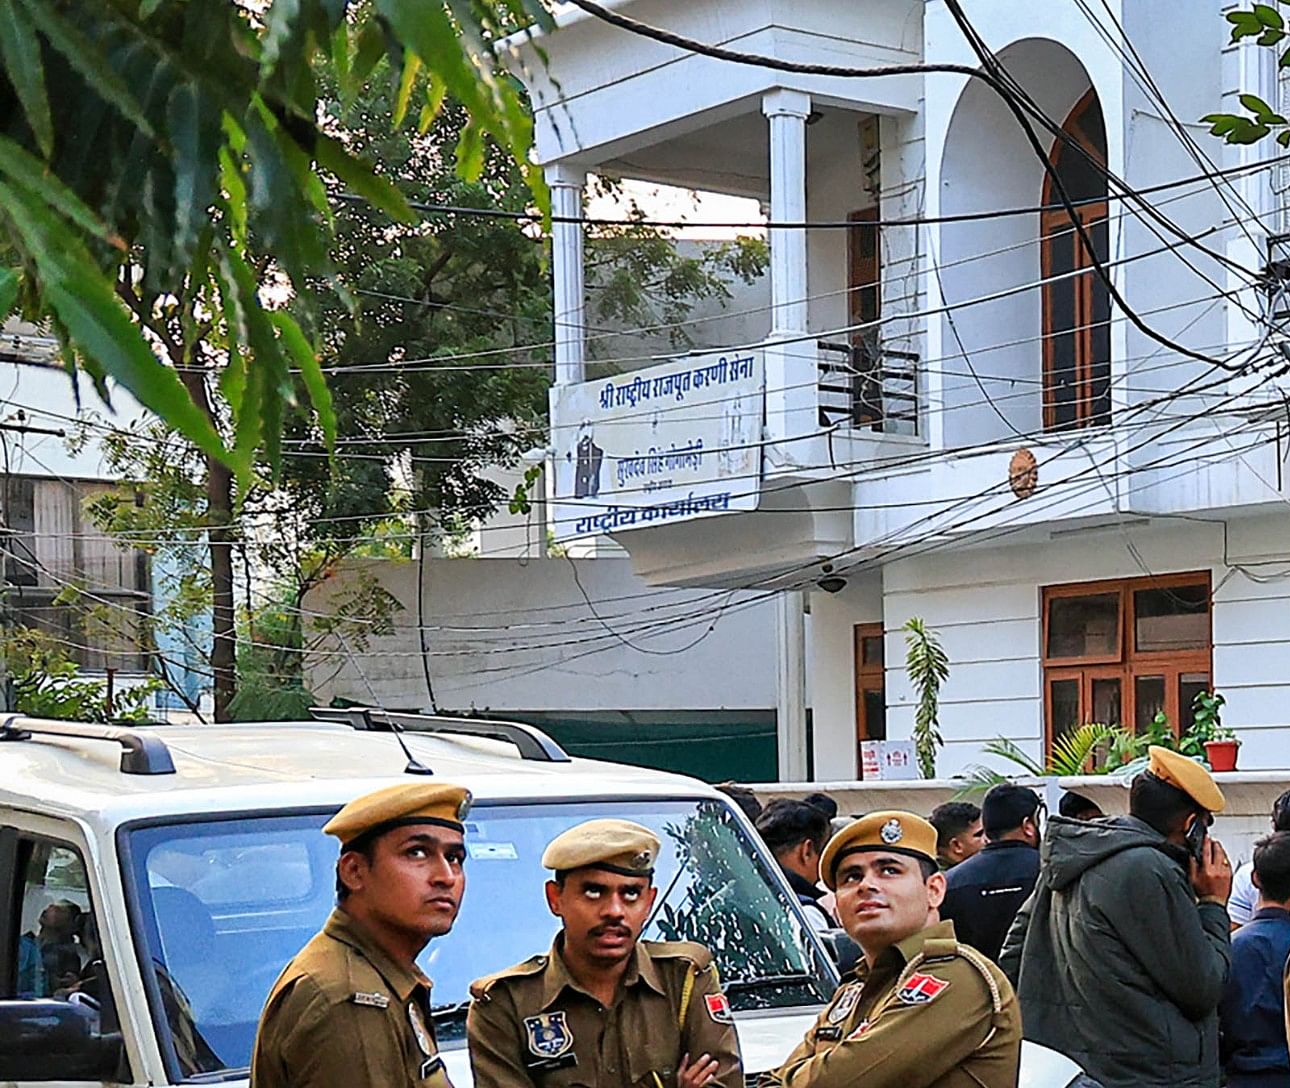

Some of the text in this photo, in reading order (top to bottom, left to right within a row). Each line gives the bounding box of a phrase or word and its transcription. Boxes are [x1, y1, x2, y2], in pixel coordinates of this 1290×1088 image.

[599, 354, 754, 409] श्री राष्ट्रीय राजपूत करणी सेना
[575, 504, 637, 534] राष्ट्रीय
